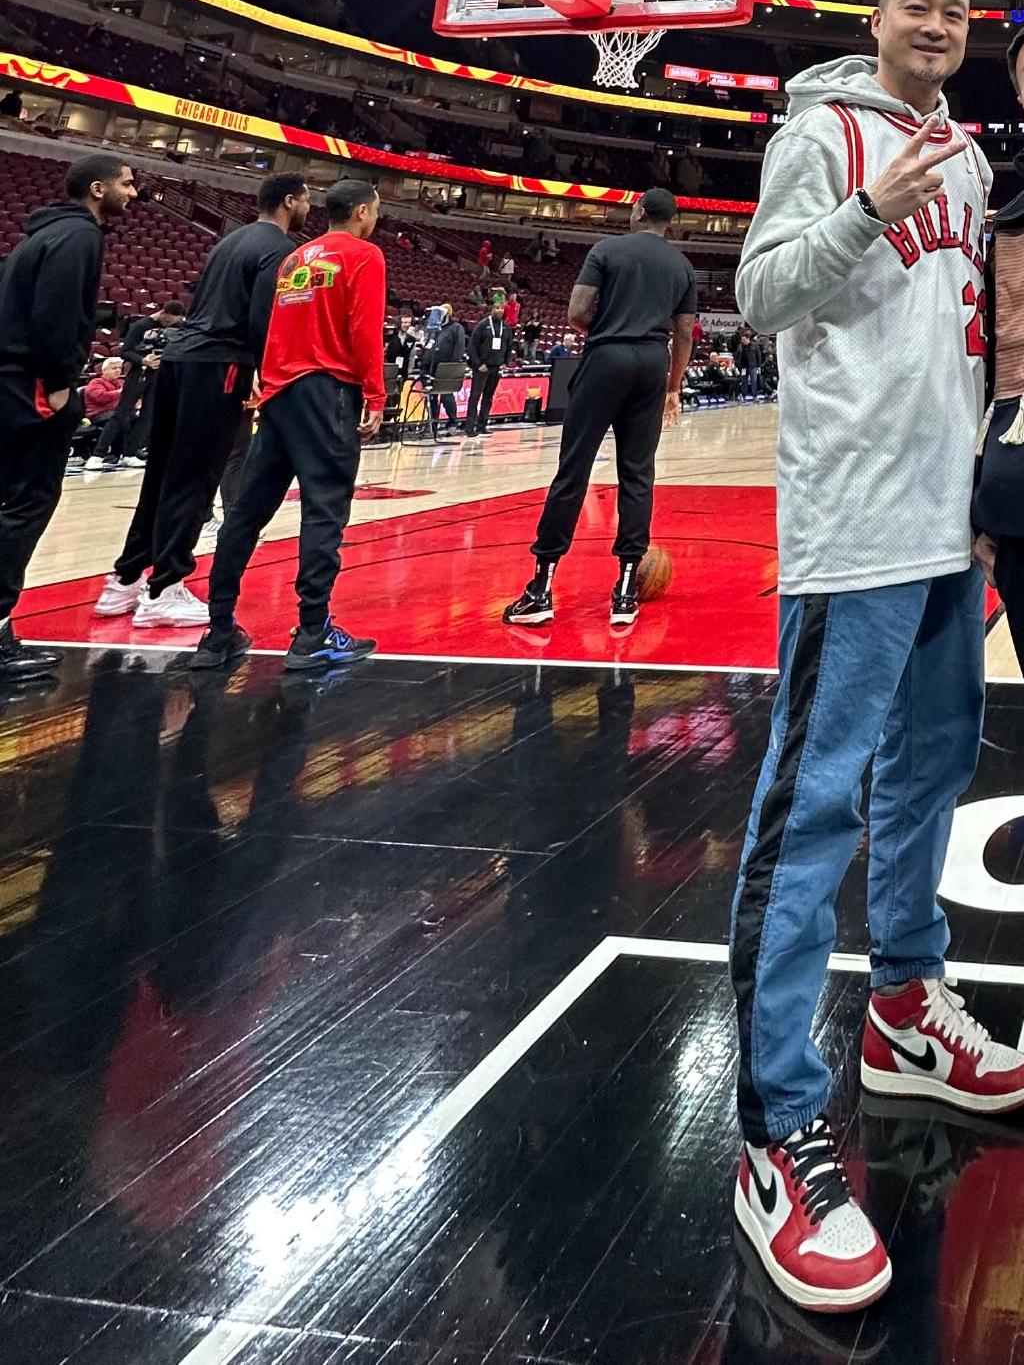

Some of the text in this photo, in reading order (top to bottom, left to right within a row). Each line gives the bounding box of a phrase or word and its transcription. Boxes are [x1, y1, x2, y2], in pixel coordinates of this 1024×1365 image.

[174, 98, 250, 132] CHICAGO BULLS
[882, 194, 985, 275] BULL
